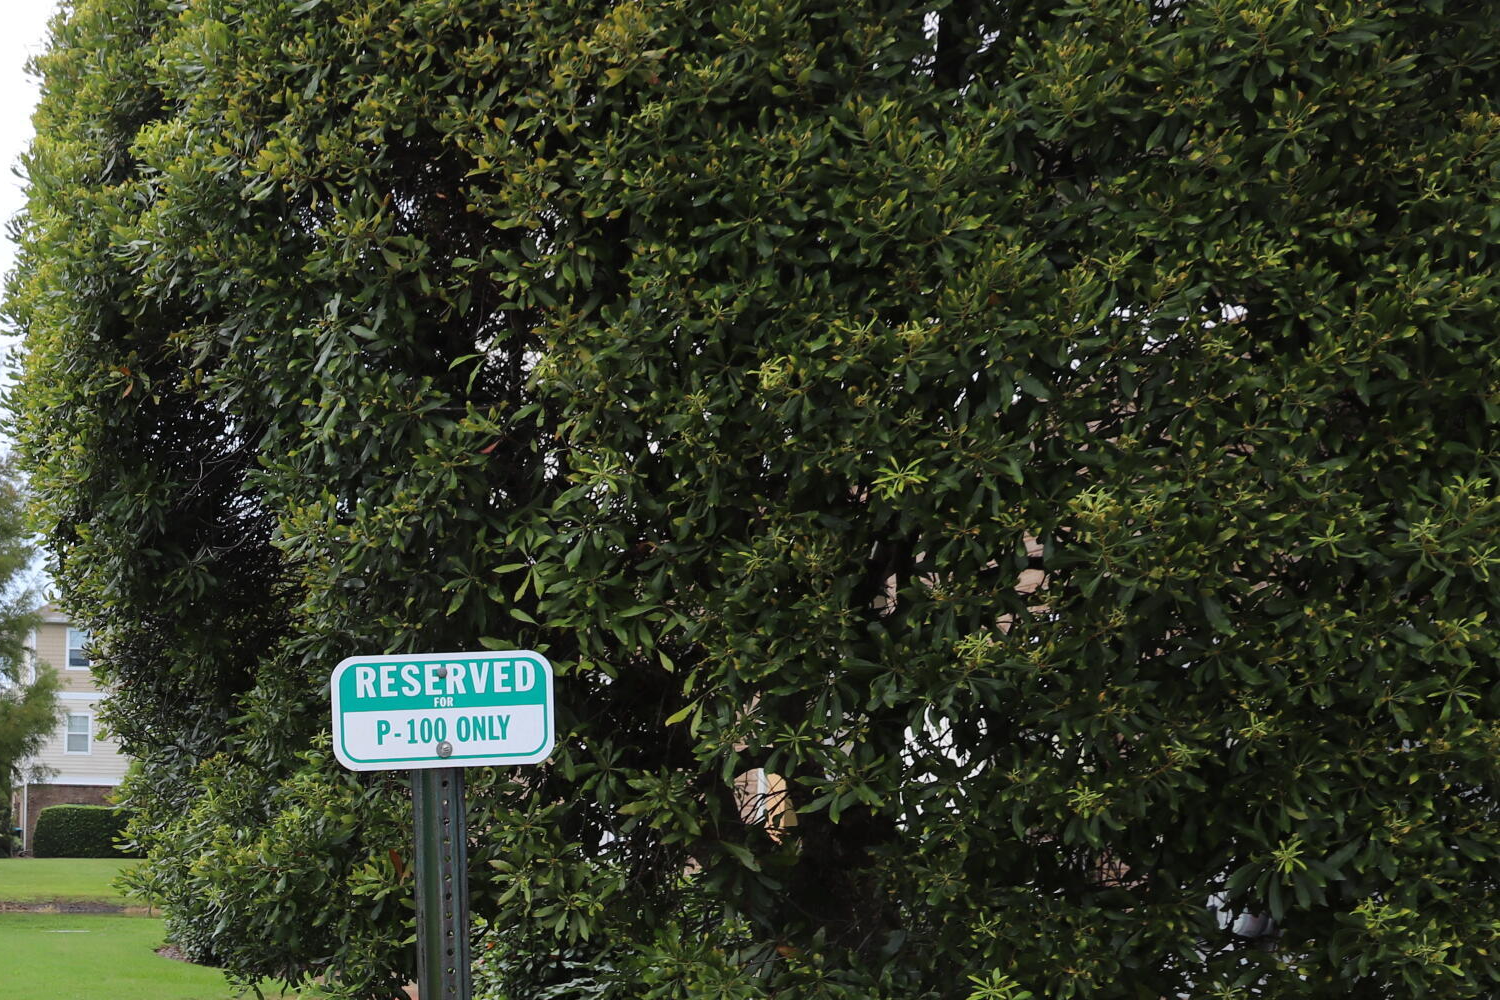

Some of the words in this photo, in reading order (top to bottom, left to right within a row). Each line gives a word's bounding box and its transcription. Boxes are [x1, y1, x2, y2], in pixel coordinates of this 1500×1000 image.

[355, 660, 536, 699] RESERVED
[433, 696, 454, 708] FOR
[376, 717, 447, 745] P-100
[456, 714, 511, 742] ONLY
